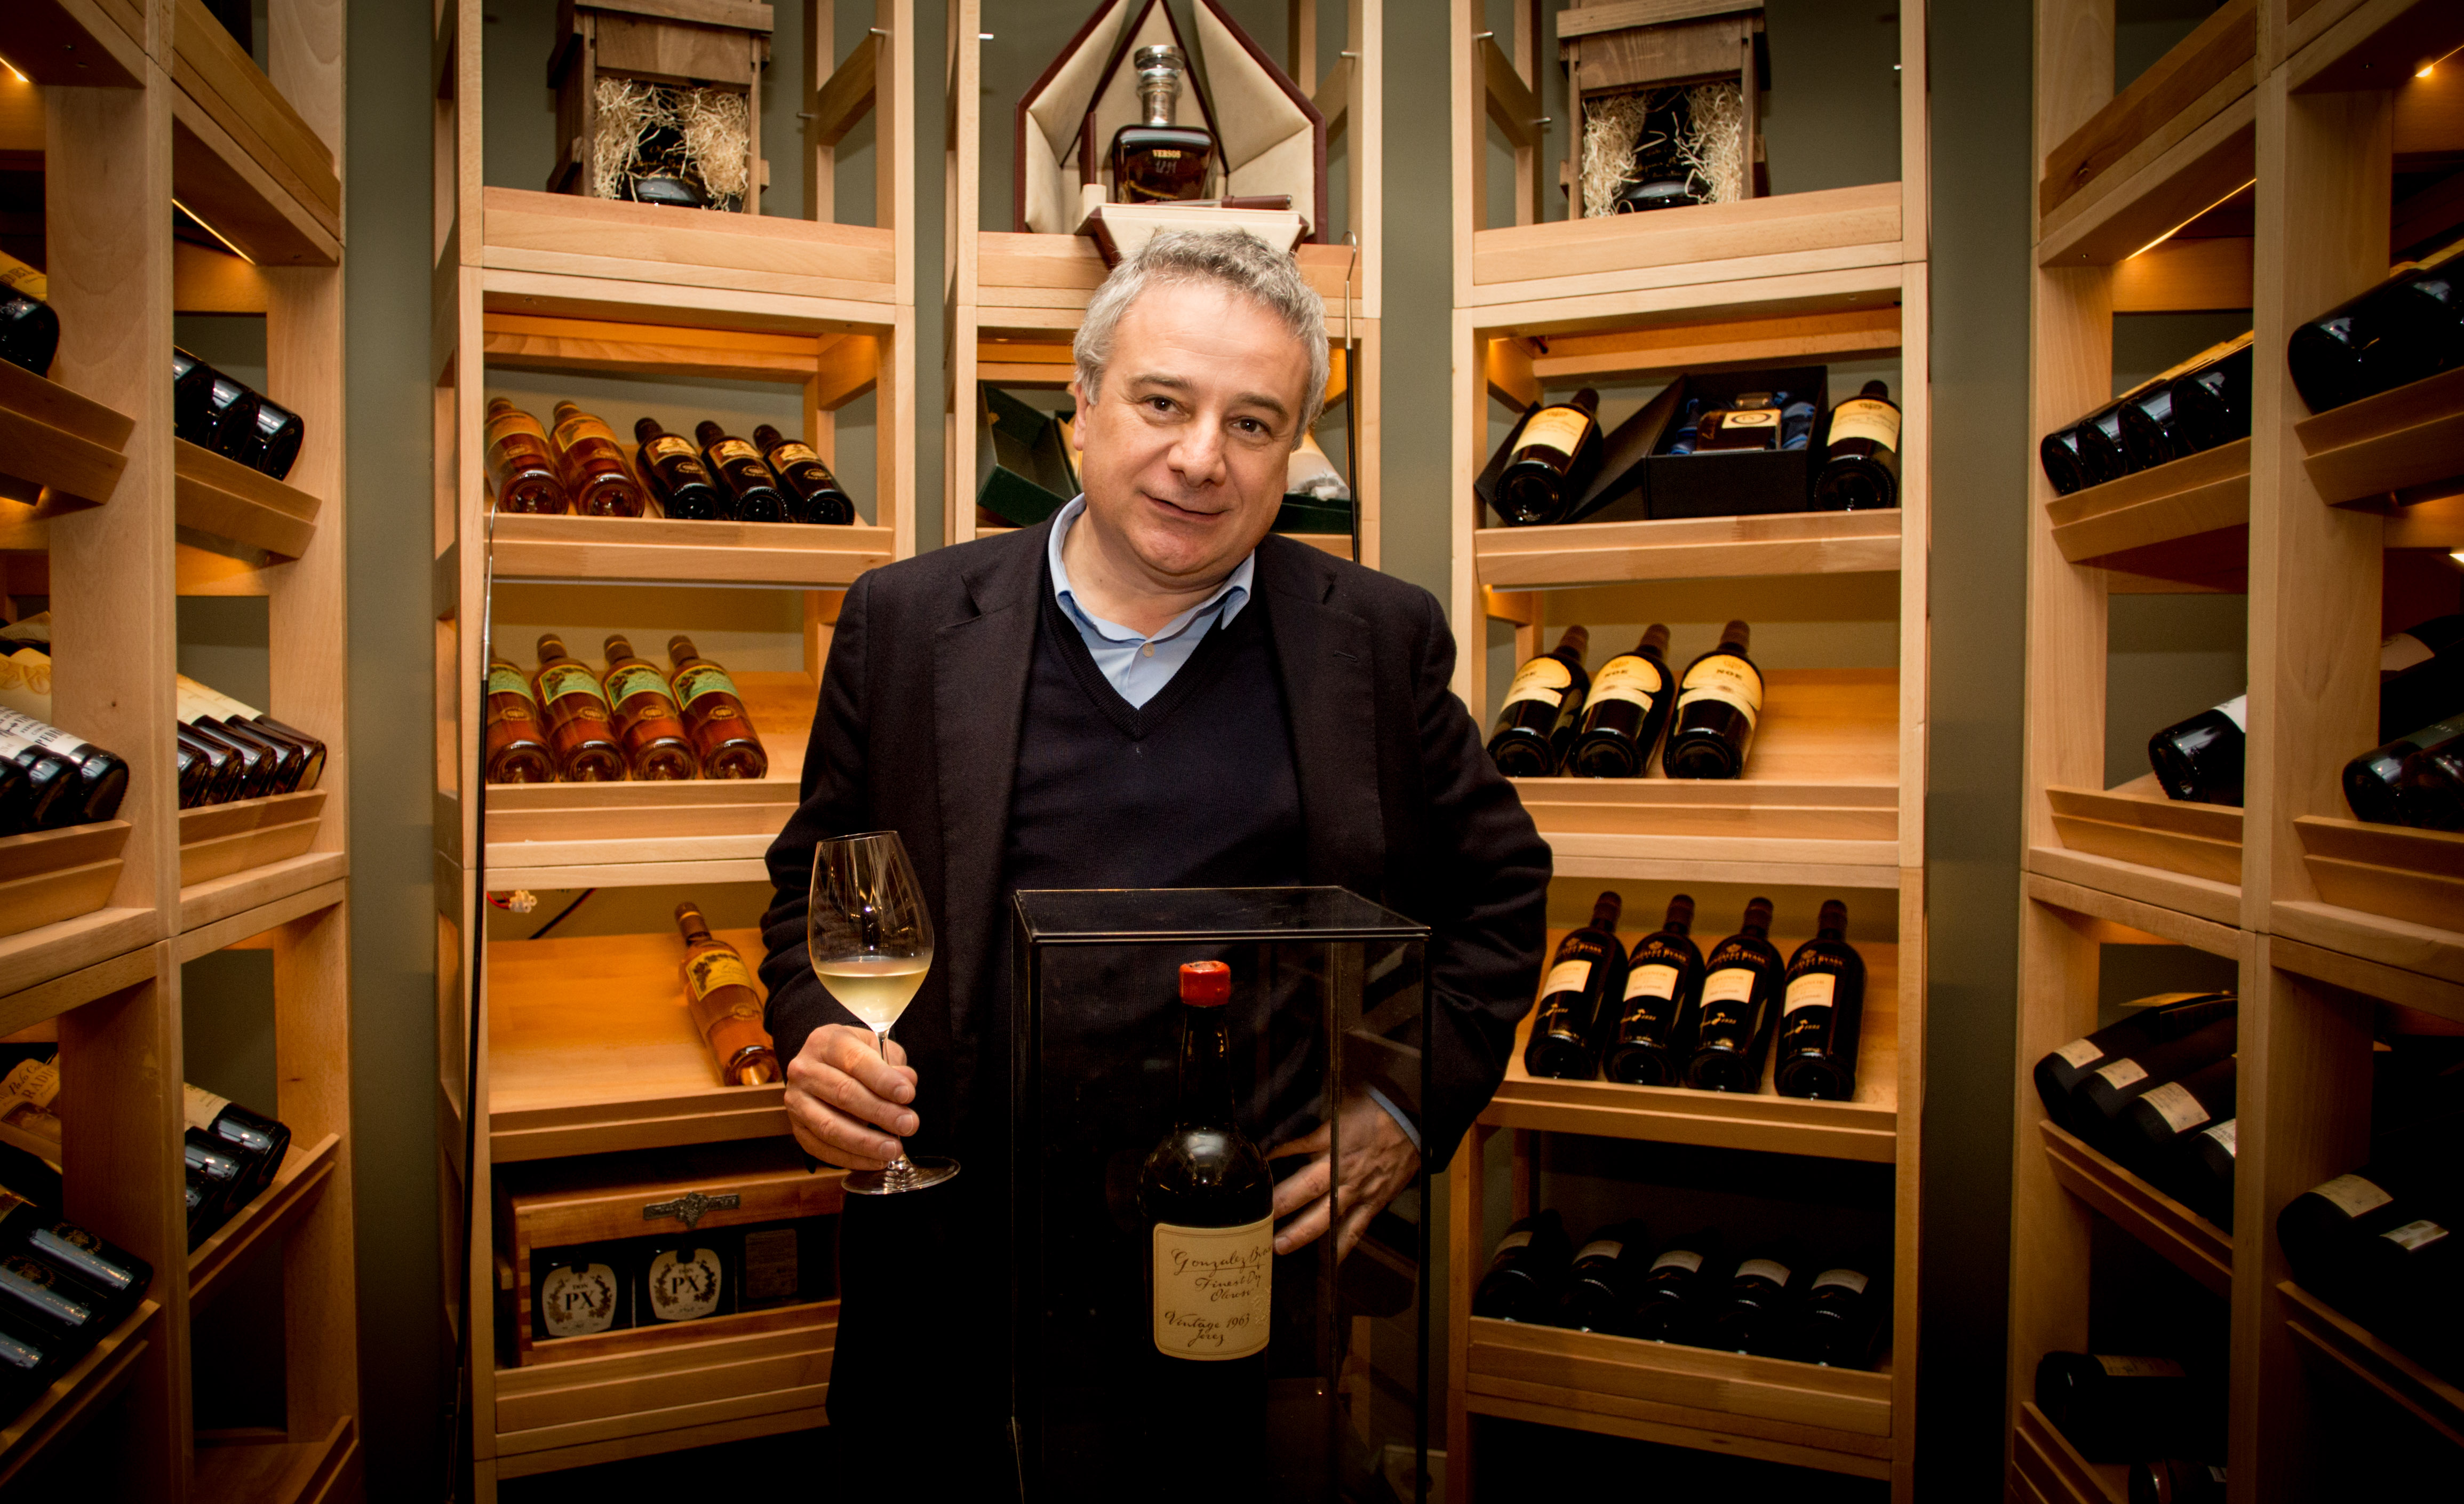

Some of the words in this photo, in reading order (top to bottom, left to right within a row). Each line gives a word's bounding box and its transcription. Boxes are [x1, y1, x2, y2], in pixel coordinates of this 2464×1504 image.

[1152, 149, 1182, 159] VERSOS
[1717, 669, 1743, 680] NOE
[1171, 1248, 1246, 1277] Gonzalez
[672, 1274, 699, 1294] PX
[1195, 1276, 1245, 1291] Finest
[565, 1290, 594, 1310] PX
[1165, 1310, 1220, 1332] Vintage
[1226, 1313, 1250, 1330] 1963
[1187, 1329, 1224, 1347] Jerez
